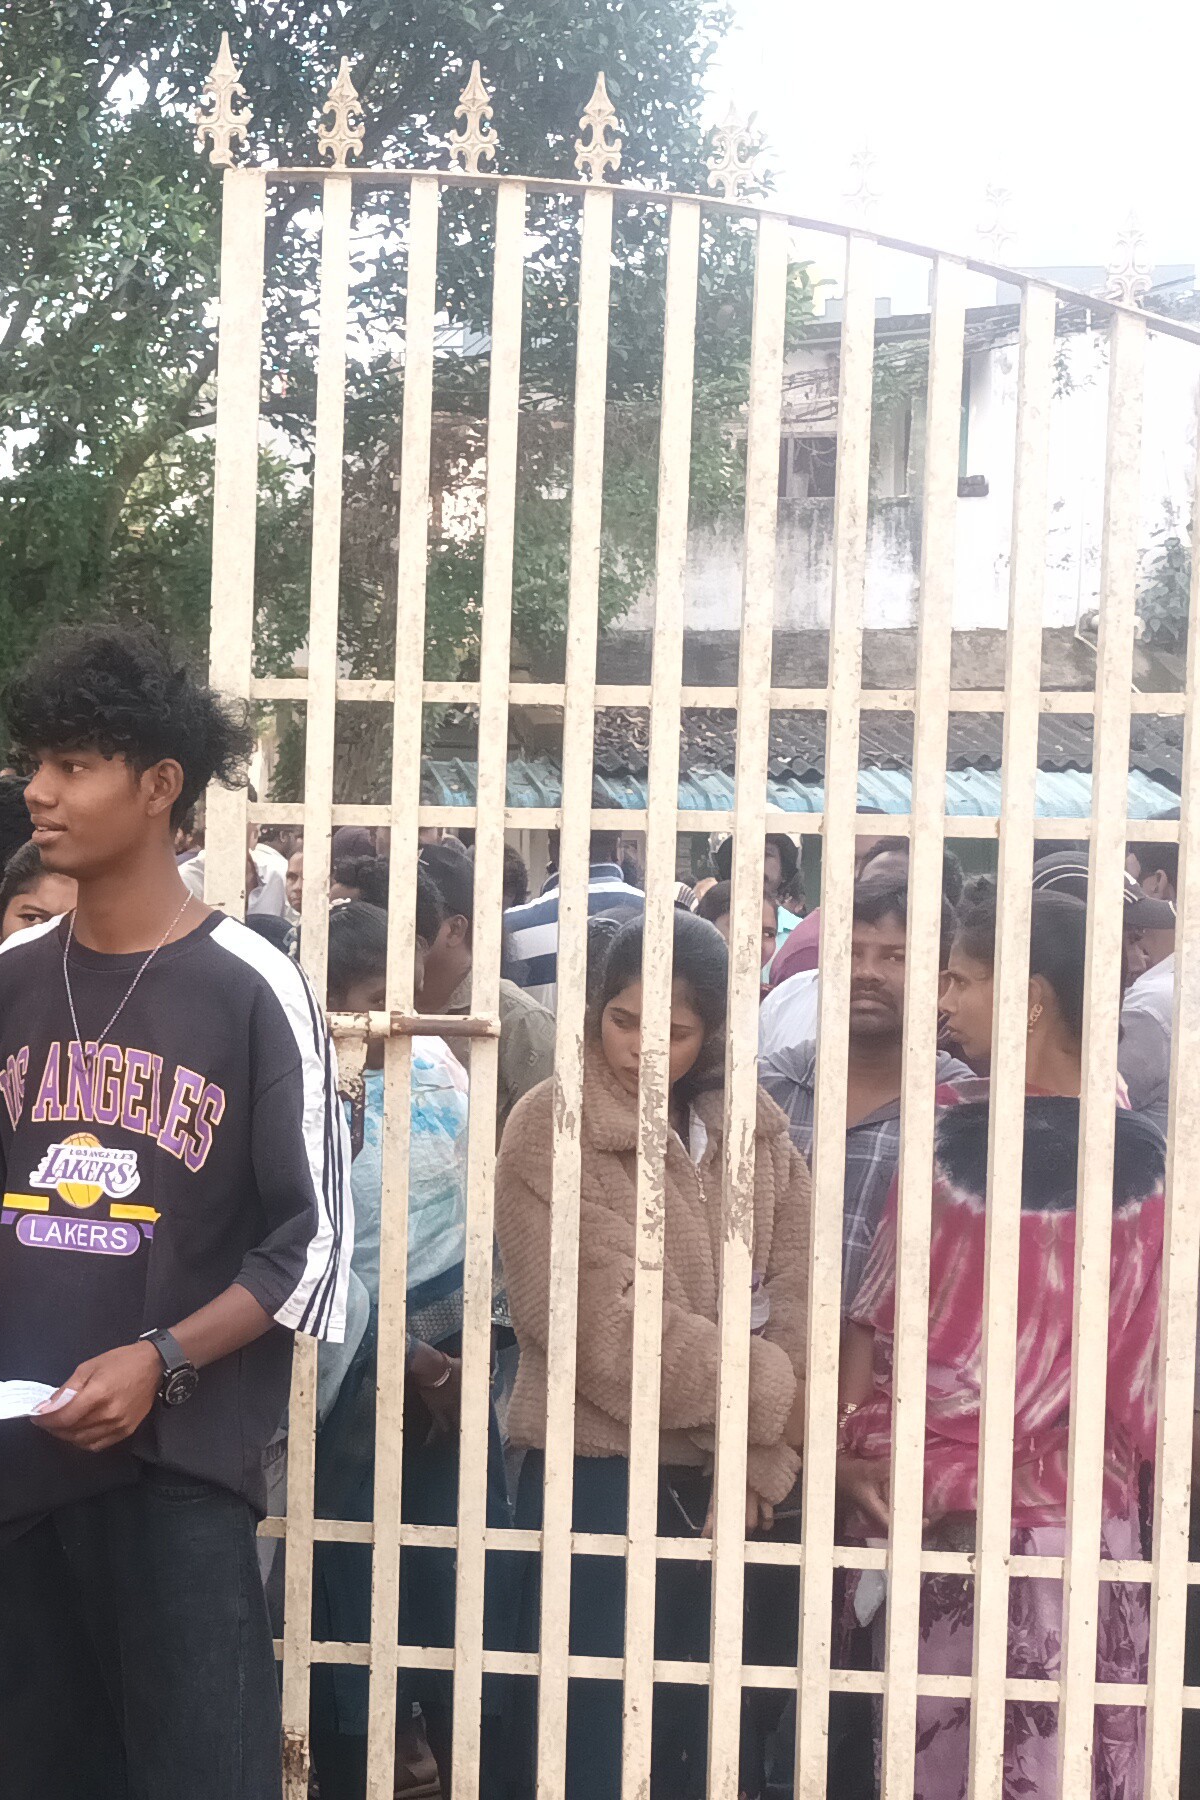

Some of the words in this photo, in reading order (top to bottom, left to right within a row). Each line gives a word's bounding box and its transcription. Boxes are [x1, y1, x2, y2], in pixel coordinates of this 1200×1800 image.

[31, 1041, 226, 1173] ANGELES
[37, 1147, 137, 1194] LAKERS
[29, 1219, 129, 1250] LAKERS
